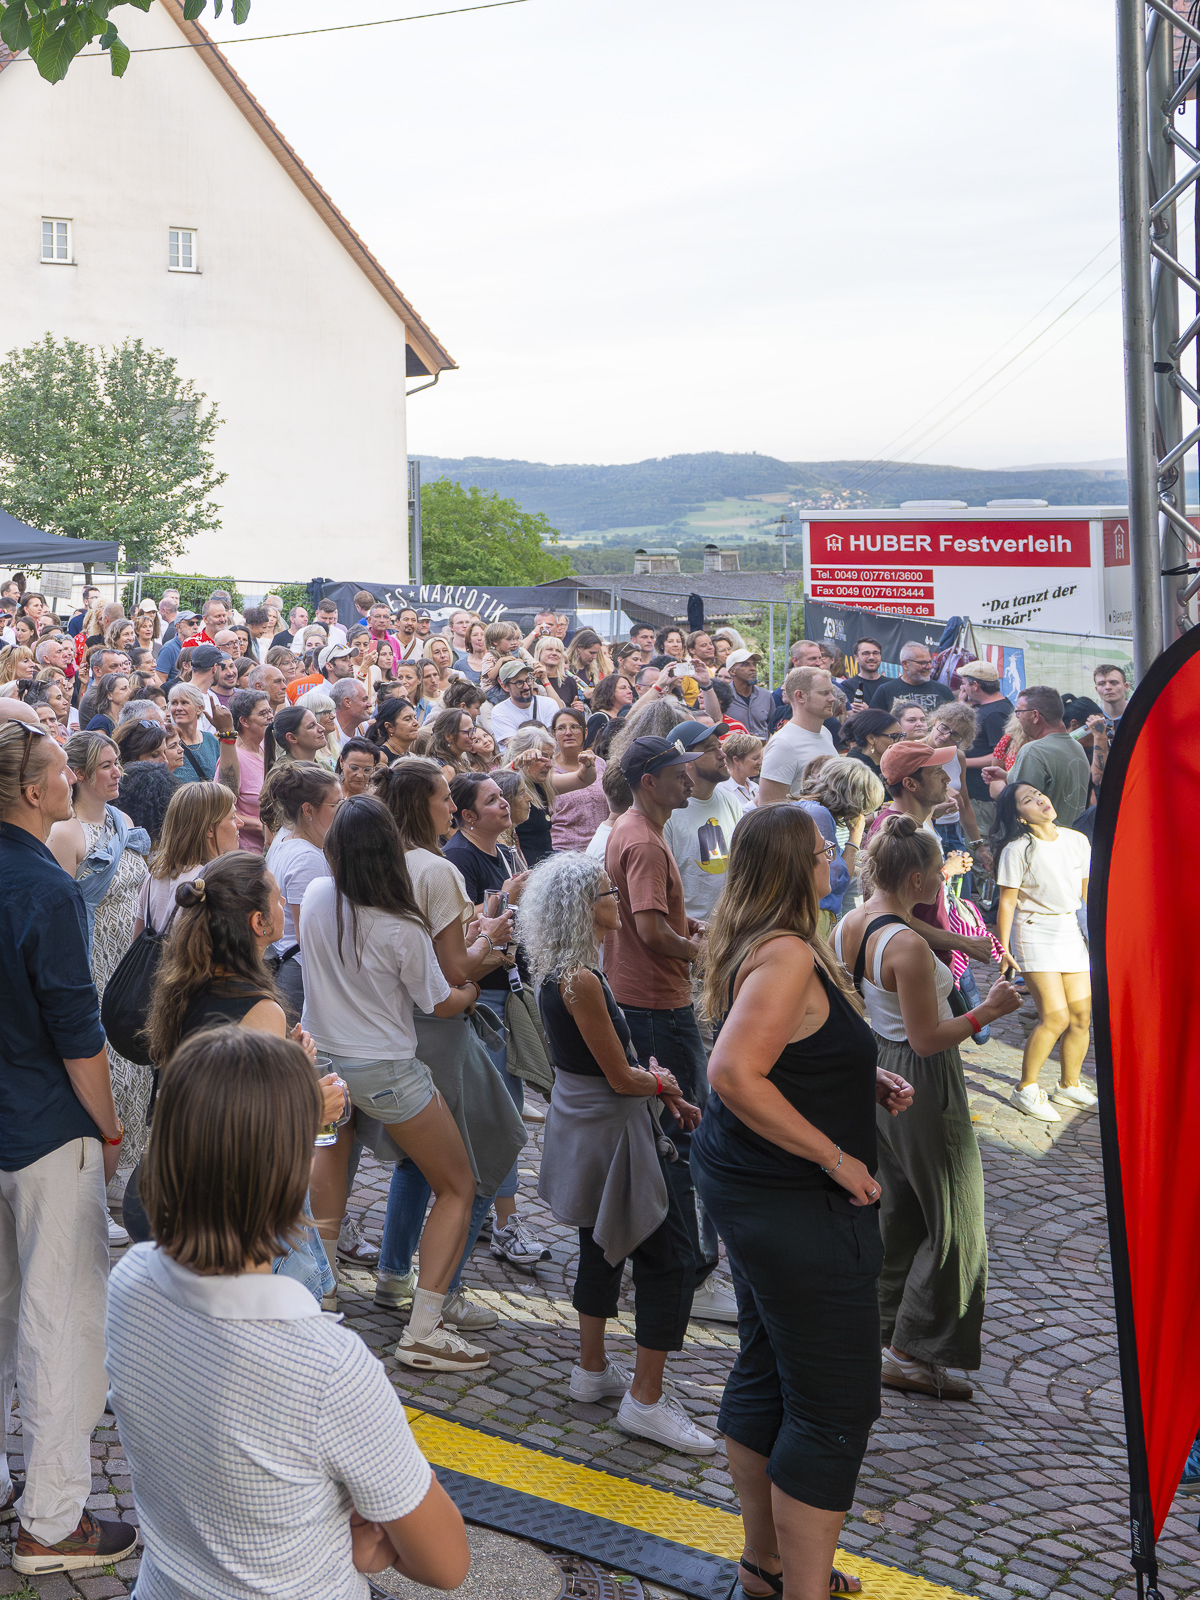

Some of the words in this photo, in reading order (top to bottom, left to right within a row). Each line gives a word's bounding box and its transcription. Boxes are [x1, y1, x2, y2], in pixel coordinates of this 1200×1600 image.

[849, 534, 933, 552] HUBER
[939, 534, 1072, 553] Festverleih
[816, 570, 832, 579] Tel.
[835, 571, 858, 580] 0049
[860, 571, 923, 582] (0)7761/3600
[817, 586, 834, 595] Fax
[836, 587, 859, 596] 0049
[862, 588, 925, 598] (0)7761/3444
[1012, 589, 1049, 607] tanzt
[1052, 584, 1078, 600] der
[419, 584, 509, 624] NARCOTIK
[1112, 609, 1133, 625] Bierwage
[1131, 1518, 1141, 1554] Easyflag
